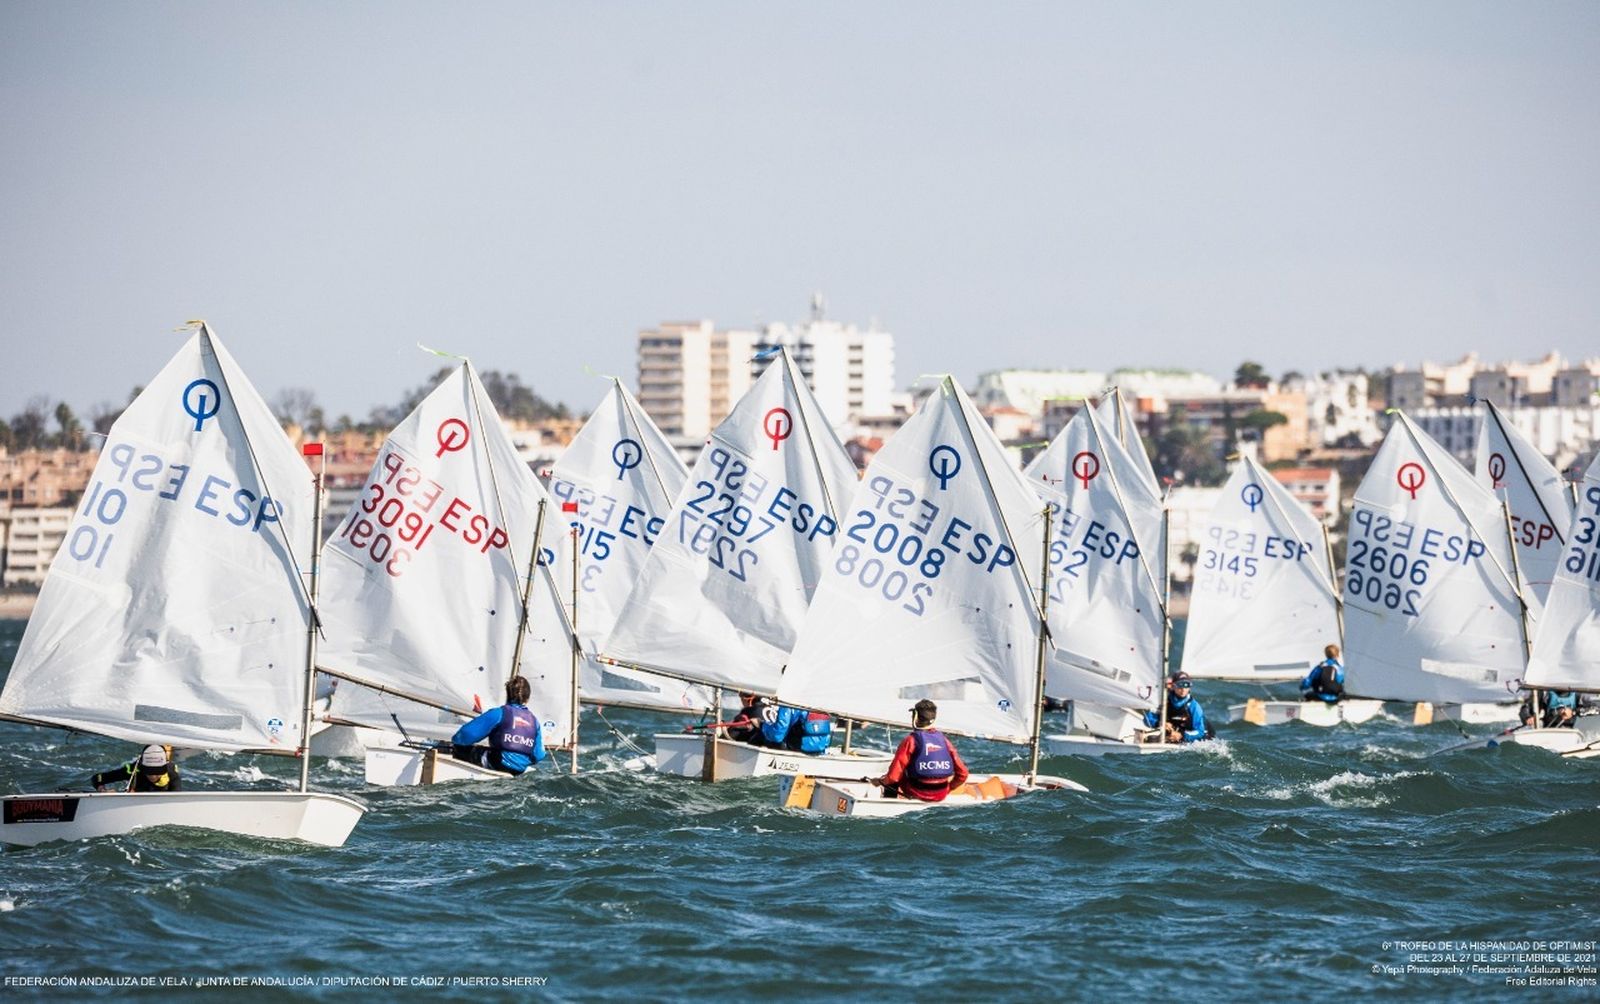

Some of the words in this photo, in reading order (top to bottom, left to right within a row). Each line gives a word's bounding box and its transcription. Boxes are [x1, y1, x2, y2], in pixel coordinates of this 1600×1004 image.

[194, 475, 284, 532] ESP
[361, 484, 434, 550] 3091
[439, 497, 509, 554] ESP
[619, 505, 666, 546] ES
[687, 480, 775, 545] 2297
[768, 487, 836, 543] ESP
[847, 510, 946, 579] 2008
[941, 517, 1016, 574] ESP
[1050, 540, 1088, 578] 62
[1082, 521, 1141, 565] ESP
[1204, 549, 1259, 577] 3145
[1264, 536, 1313, 562] ESP
[1350, 539, 1430, 586] 2606
[1420, 528, 1486, 566] ESP
[504, 733, 535, 748] RCMS
[919, 760, 951, 770] RCMS
